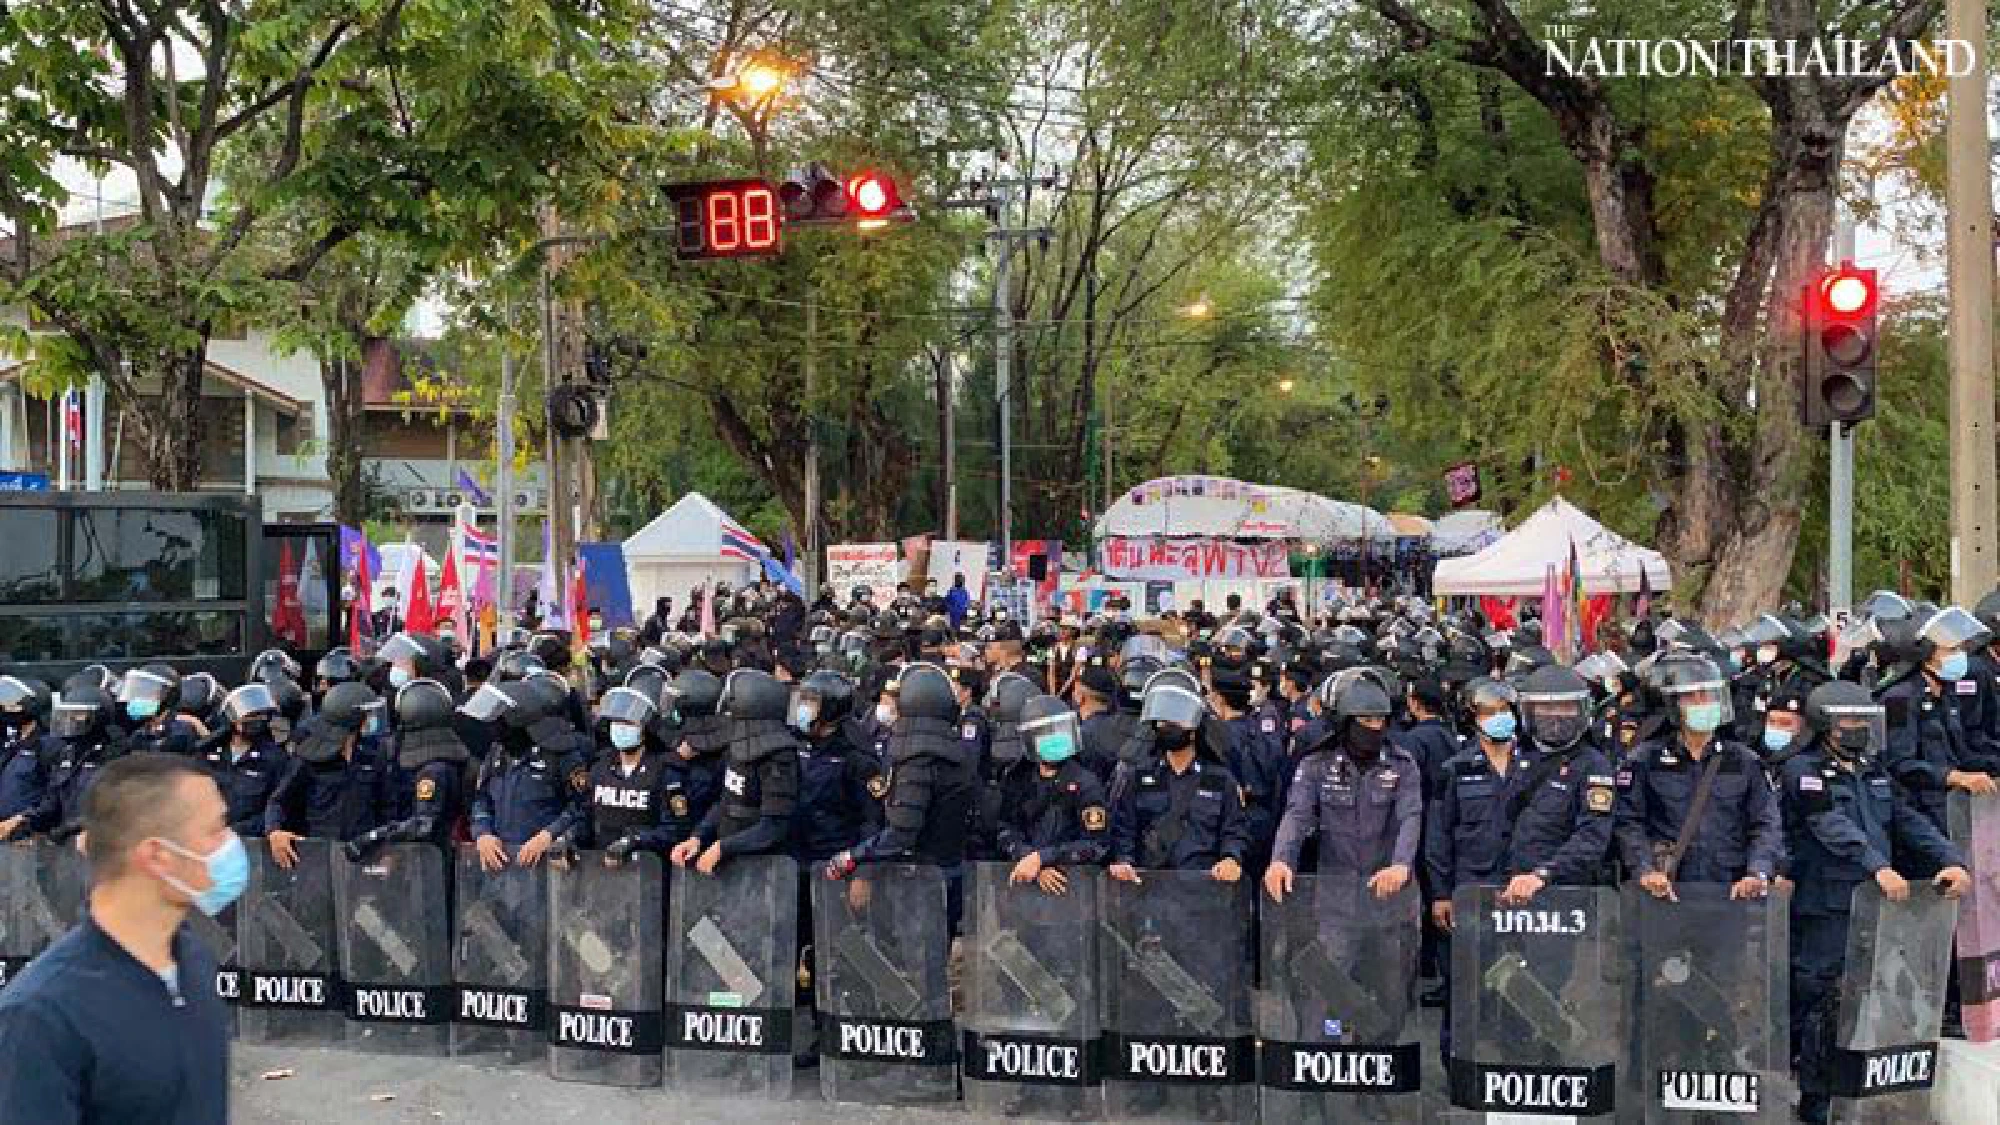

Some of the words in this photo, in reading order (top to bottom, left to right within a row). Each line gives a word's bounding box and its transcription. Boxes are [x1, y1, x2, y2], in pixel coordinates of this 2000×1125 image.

[594, 785, 650, 809] POLICE
[255, 976, 325, 1002] POLICE
[356, 989, 425, 1018] POLICE
[461, 989, 527, 1023] POLICE
[559, 1011, 633, 1047] POLICE
[683, 1011, 763, 1045] POLICE
[840, 1022, 925, 1058] POLICE
[985, 1040, 1078, 1078] POLICE
[1130, 1041, 1227, 1077] POLICE
[1294, 1051, 1395, 1085] POLICE
[1865, 1050, 1932, 1088] POLICE
[1484, 1071, 1588, 1108] POLICE
